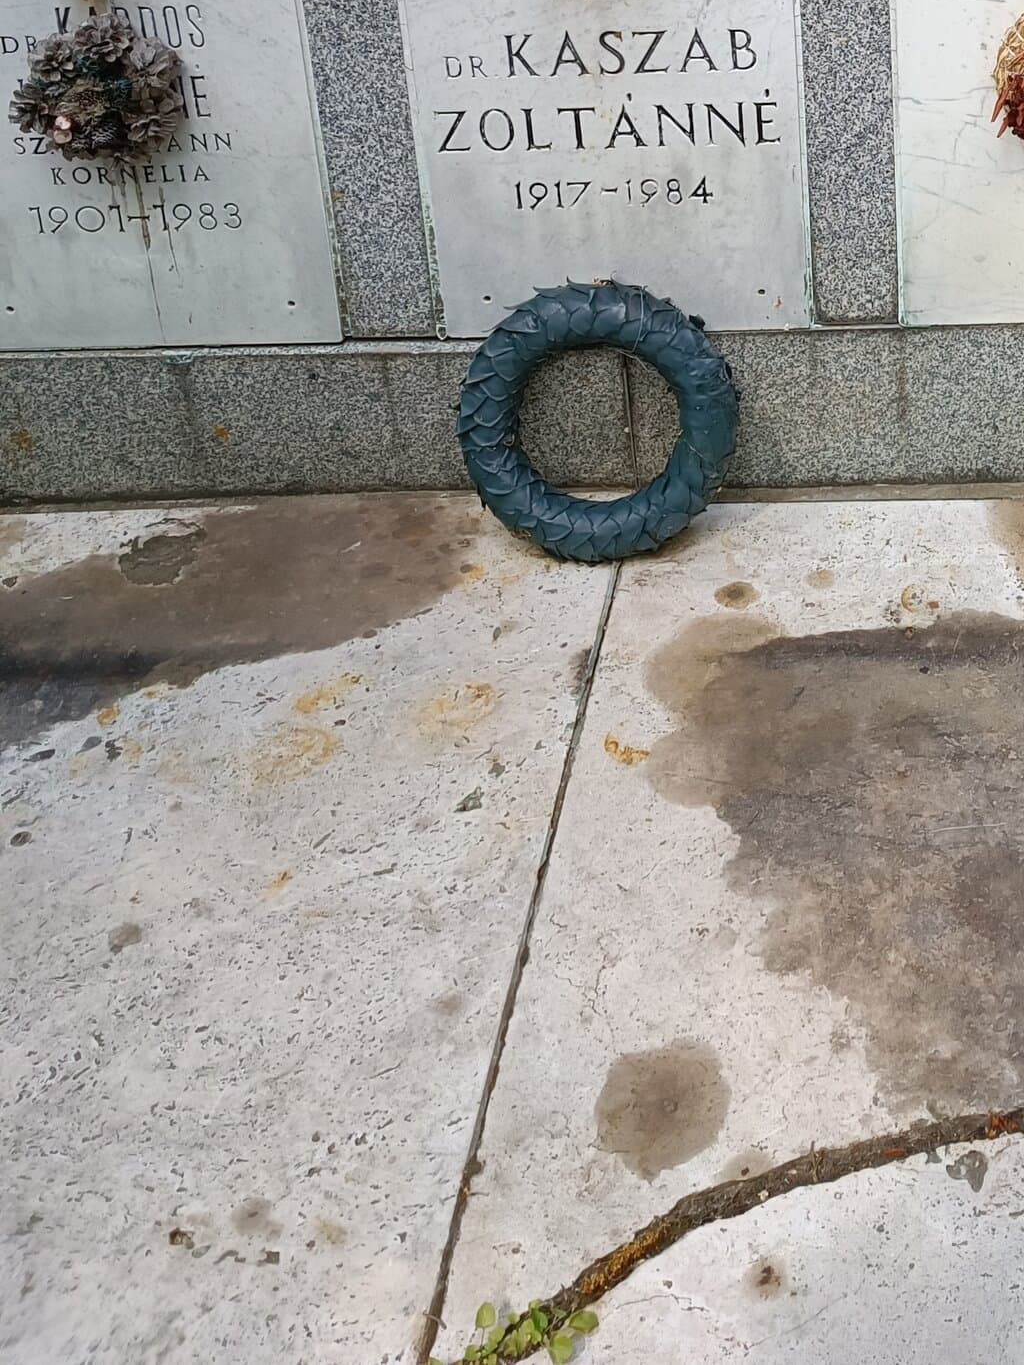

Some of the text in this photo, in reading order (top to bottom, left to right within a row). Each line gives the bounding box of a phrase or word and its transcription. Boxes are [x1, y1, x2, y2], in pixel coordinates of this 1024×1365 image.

[504, 27, 757, 77] KASZAB
[514, 175, 714, 210] 1917-1984
[28, 201, 243, 236] 1901-1983
